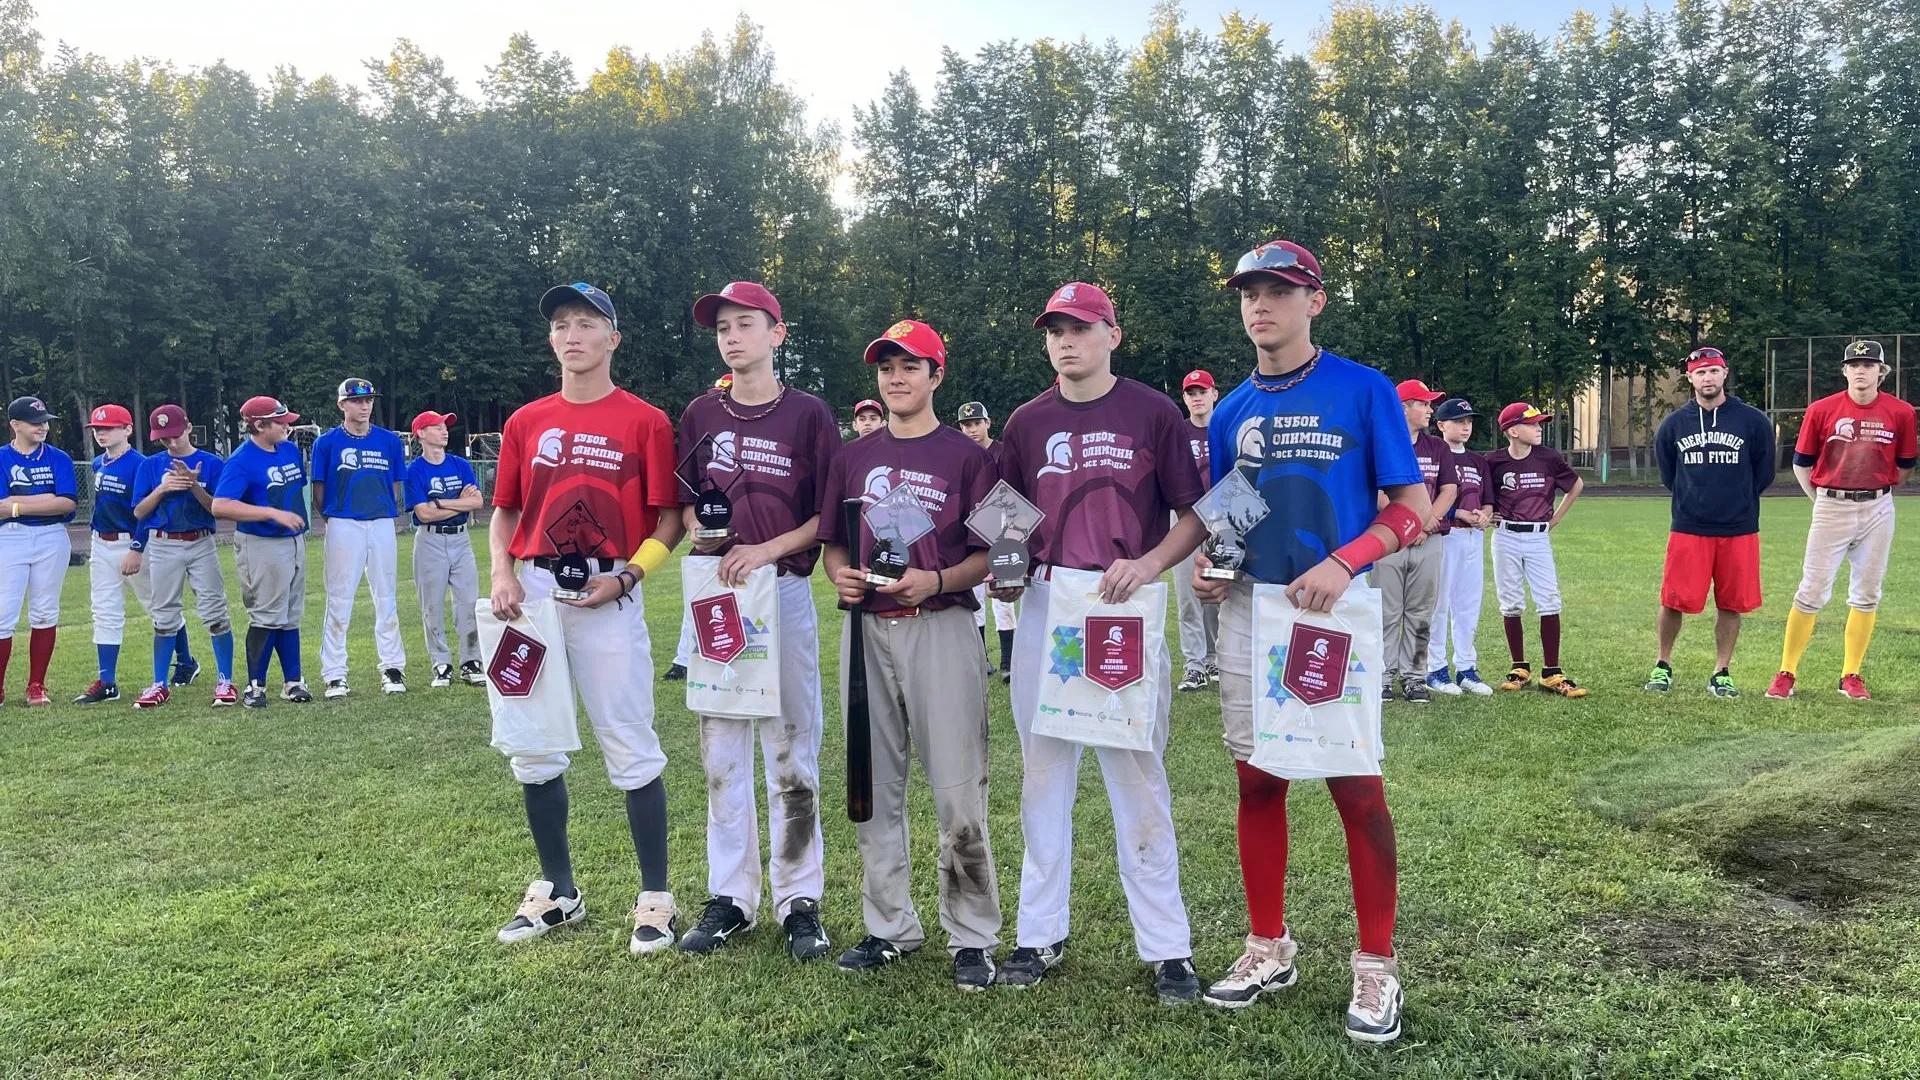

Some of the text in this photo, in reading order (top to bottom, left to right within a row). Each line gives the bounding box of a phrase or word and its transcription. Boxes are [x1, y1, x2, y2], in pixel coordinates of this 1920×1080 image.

[1273, 416, 1320, 429] КУБОК
[573, 433, 608, 446] КУБОК
[742, 436, 778, 451] КУБОК
[1081, 432, 1116, 445] КУБОК
[1272, 431, 1343, 449] ОЛИМПИИ
[1677, 431, 1745, 453] ABERCROMBIE
[571, 445, 624, 462] ОЛИМПИИ
[741, 449, 792, 468] ОЛИМПИИ
[1082, 444, 1135, 460] ОЛИМПИИ
[1271, 448, 1340, 461] «ВСЕ ЗВЕЗДЫ»
[1684, 450, 1739, 464] AND FITCH
